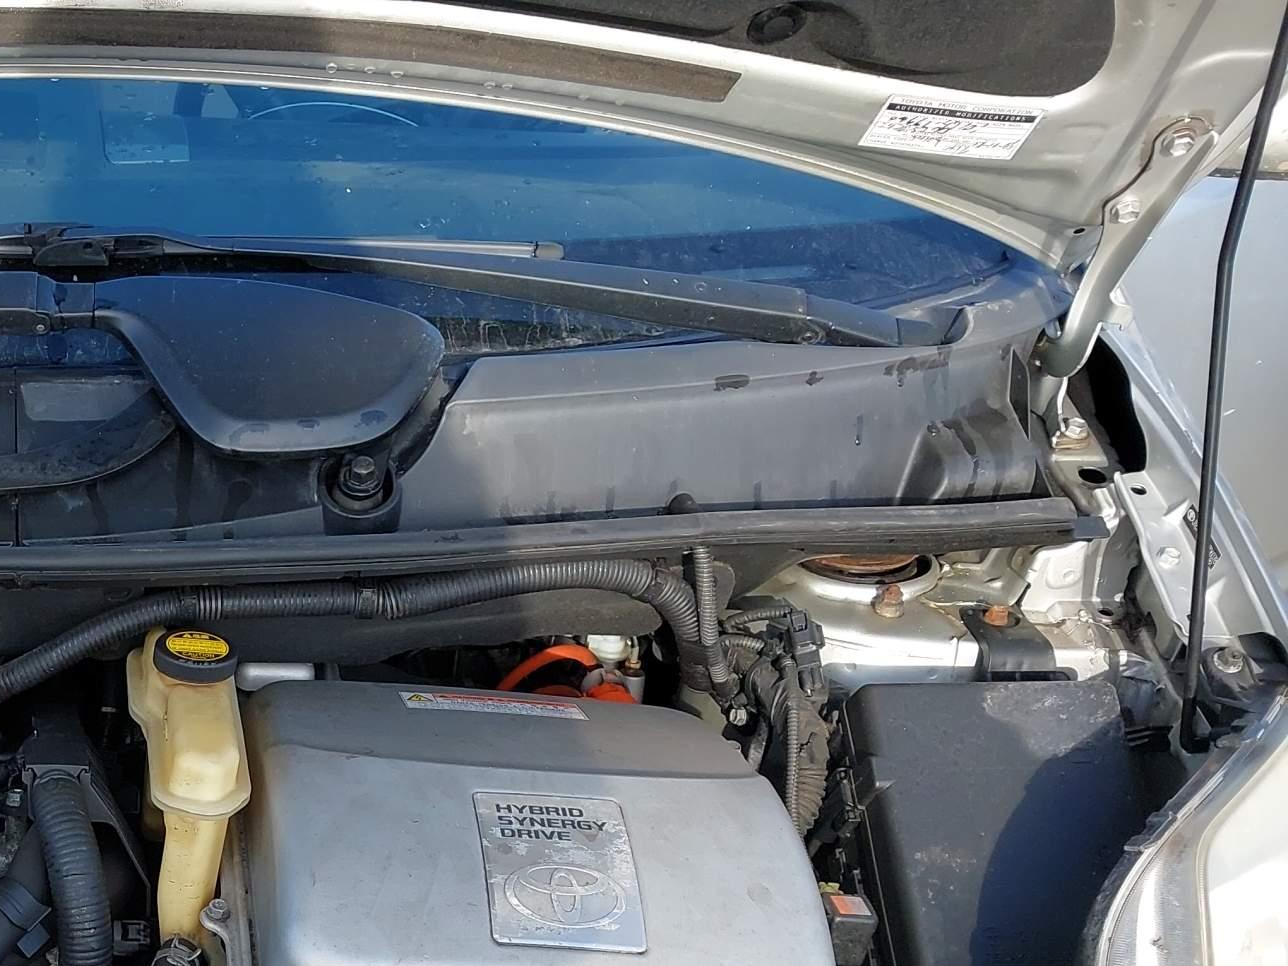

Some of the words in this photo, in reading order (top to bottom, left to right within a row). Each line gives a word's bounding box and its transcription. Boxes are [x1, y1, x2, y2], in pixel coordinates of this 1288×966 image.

[496, 804, 583, 817] HYBRID
[498, 816, 607, 831] SYNERGY
[501, 828, 571, 841] DRIVE
